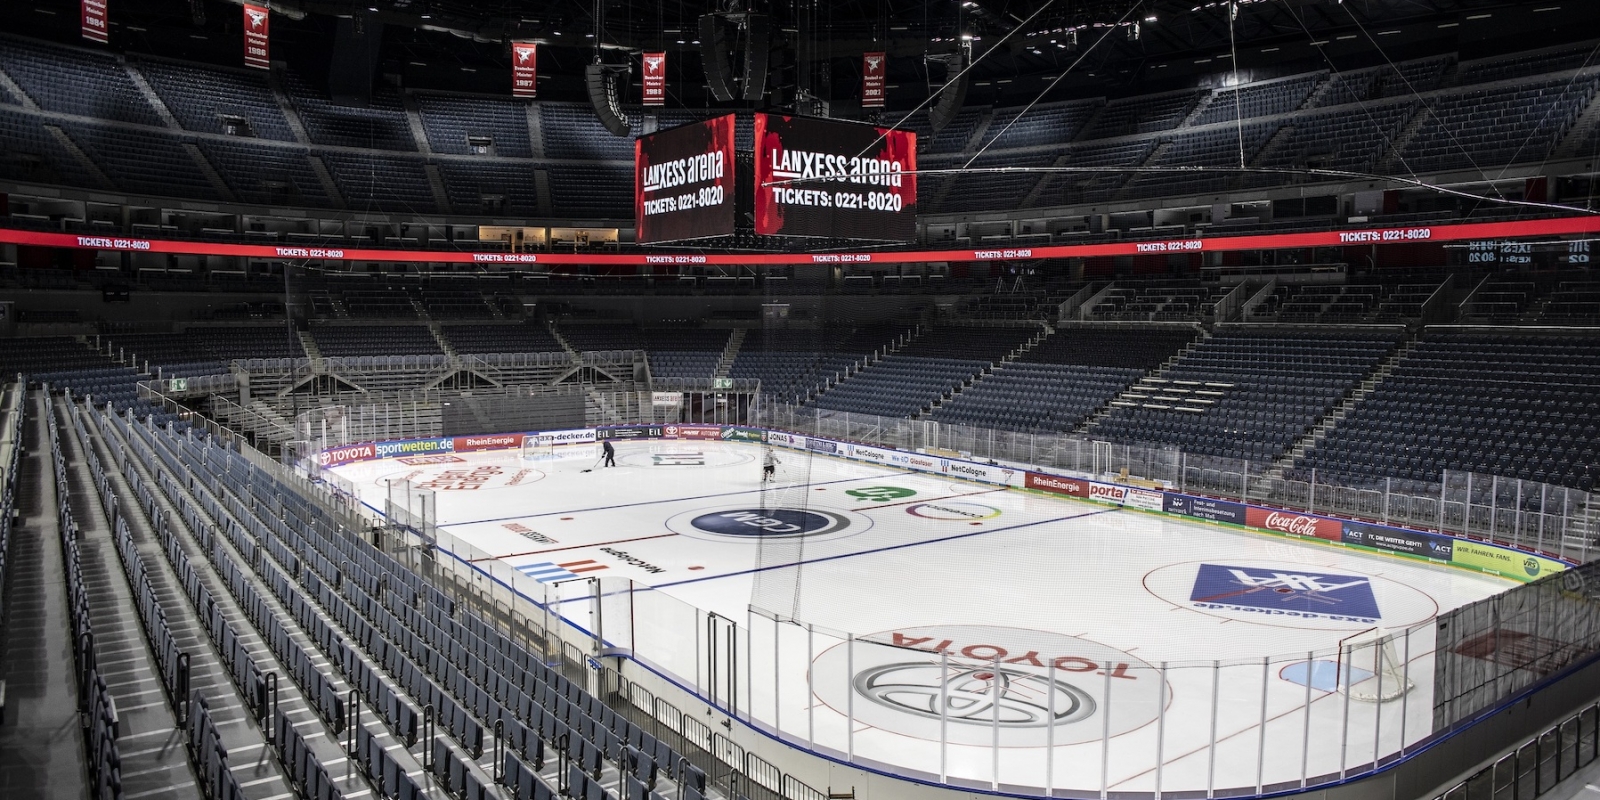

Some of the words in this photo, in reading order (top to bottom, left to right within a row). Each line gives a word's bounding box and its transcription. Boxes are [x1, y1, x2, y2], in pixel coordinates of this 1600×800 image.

[86, 16, 104, 28] 1984
[643, 158, 686, 191] LANXESS
[687, 150, 723, 184] arena
[772, 148, 846, 182] LANXESS
[850, 157, 902, 187] arena
[643, 197, 677, 216] TICKETS:
[677, 185, 723, 210] 0221-8020
[772, 187, 832, 207] TICKETS:
[835, 191, 902, 212] 0221-8020
[1339, 232, 1380, 242] TICKETS:
[1382, 228, 1430, 240] 0221-8020
[77, 236, 113, 248] TICKETS:
[114, 239, 150, 250] 0221-8020
[1136, 242, 1167, 252] TICKETS:
[1168, 240, 1202, 251] 0221-8020
[276, 247, 308, 257] TICKETS:
[309, 249, 343, 258] 0221-8020
[473, 254, 503, 262] TICKETS:
[504, 254, 536, 262] 0221-8020
[841, 254, 871, 262] 0221-8020
[974, 251, 1003, 259] TICKETS:
[1003, 250, 1031, 258] 0221-8020
[466, 436, 514, 447] RheinEnergie
[539, 431, 595, 442] axa-decker.de
[769, 433, 787, 442] JONAS
[376, 438, 453, 456] sportwetten.de
[332, 446, 372, 462] TOYOTA
[856, 448, 885, 460] NetCologne
[951, 464, 987, 477] NetCologne
[1033, 476, 1080, 493] RheinEnergie
[1265, 511, 1320, 536] Coca-Cola
[1348, 530, 1363, 538] ACT
[1384, 536, 1405, 544] WEITER
[1435, 545, 1451, 553] ACT
[1471, 549, 1495, 559] FAHREN.
[1496, 554, 1512, 562] FANS.
[599, 547, 667, 574] NetCologne
[1523, 559, 1536, 568] VRS
[1227, 568, 1370, 592] AXA
[1193, 602, 1377, 624] axa-decker.de
[892, 632, 1138, 680] TOYOTA
